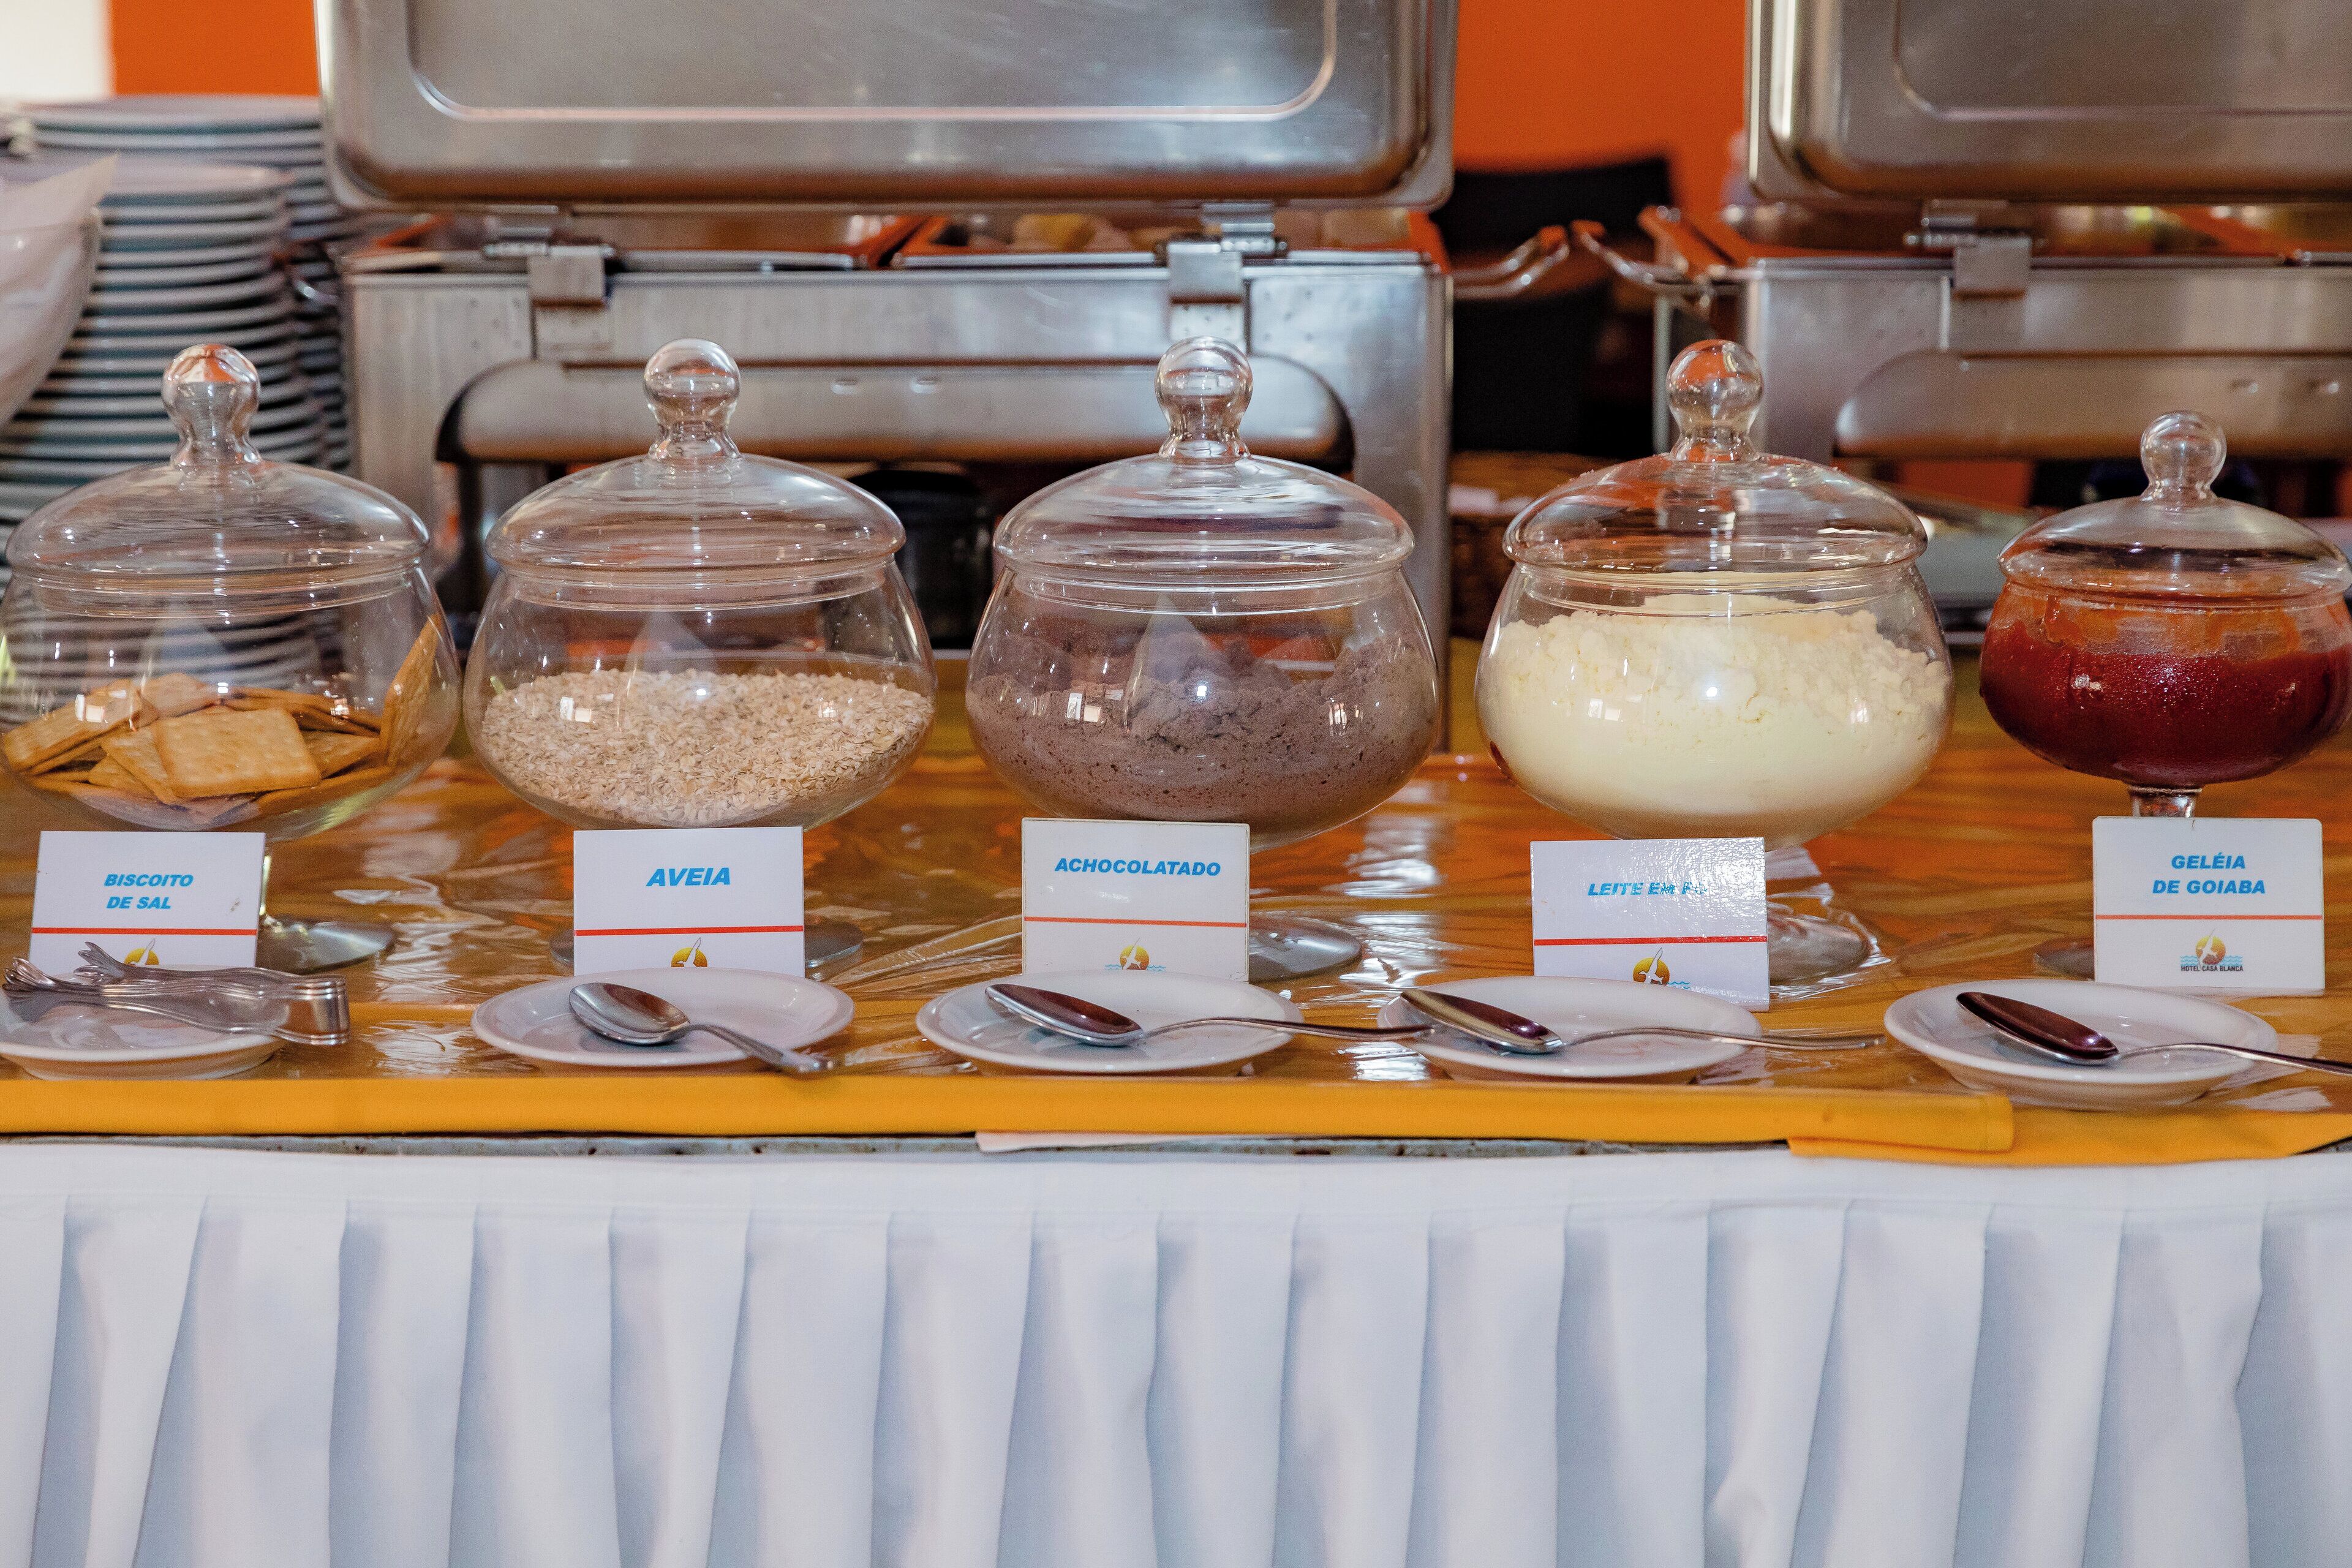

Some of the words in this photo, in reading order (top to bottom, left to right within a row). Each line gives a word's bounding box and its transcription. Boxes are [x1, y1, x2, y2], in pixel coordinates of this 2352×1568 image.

[1054, 858, 1221, 877] ACHOCOLATADO
[2171, 852, 2246, 870] GELÉIA
[104, 873, 194, 888] BISCOITO
[646, 867, 731, 887] AVEIA
[1587, 882, 1644, 896] LEITE
[1648, 882, 1676, 895] EM
[2152, 880, 2180, 894] DE
[2186, 879, 2266, 894] GOIABA
[106, 896, 133, 909] DE
[136, 896, 172, 910] SAL
